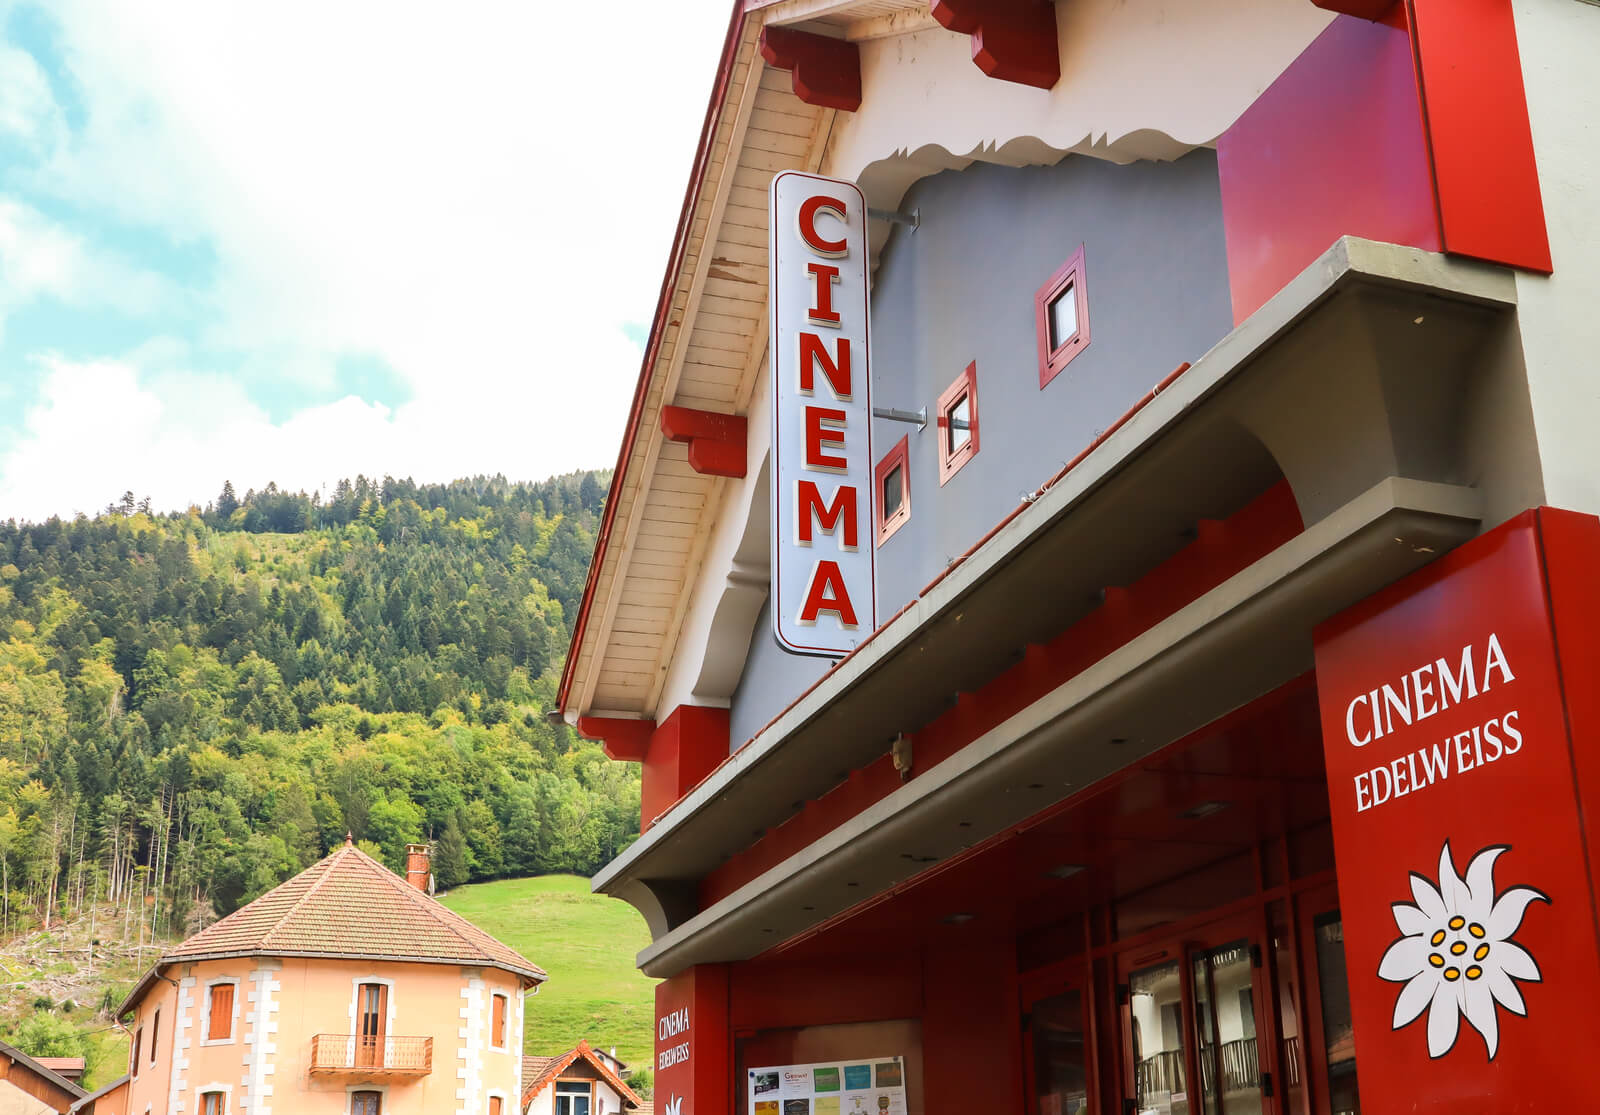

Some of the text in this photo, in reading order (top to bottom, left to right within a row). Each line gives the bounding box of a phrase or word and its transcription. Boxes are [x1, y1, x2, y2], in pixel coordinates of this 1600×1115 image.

[796, 195, 860, 630] CINEMA
[1345, 633, 1516, 747] CINEMA
[1353, 710, 1523, 813] EDELWEISS
[658, 1007, 690, 1041] CINEMA
[658, 1042, 689, 1070] EDELWEISS
